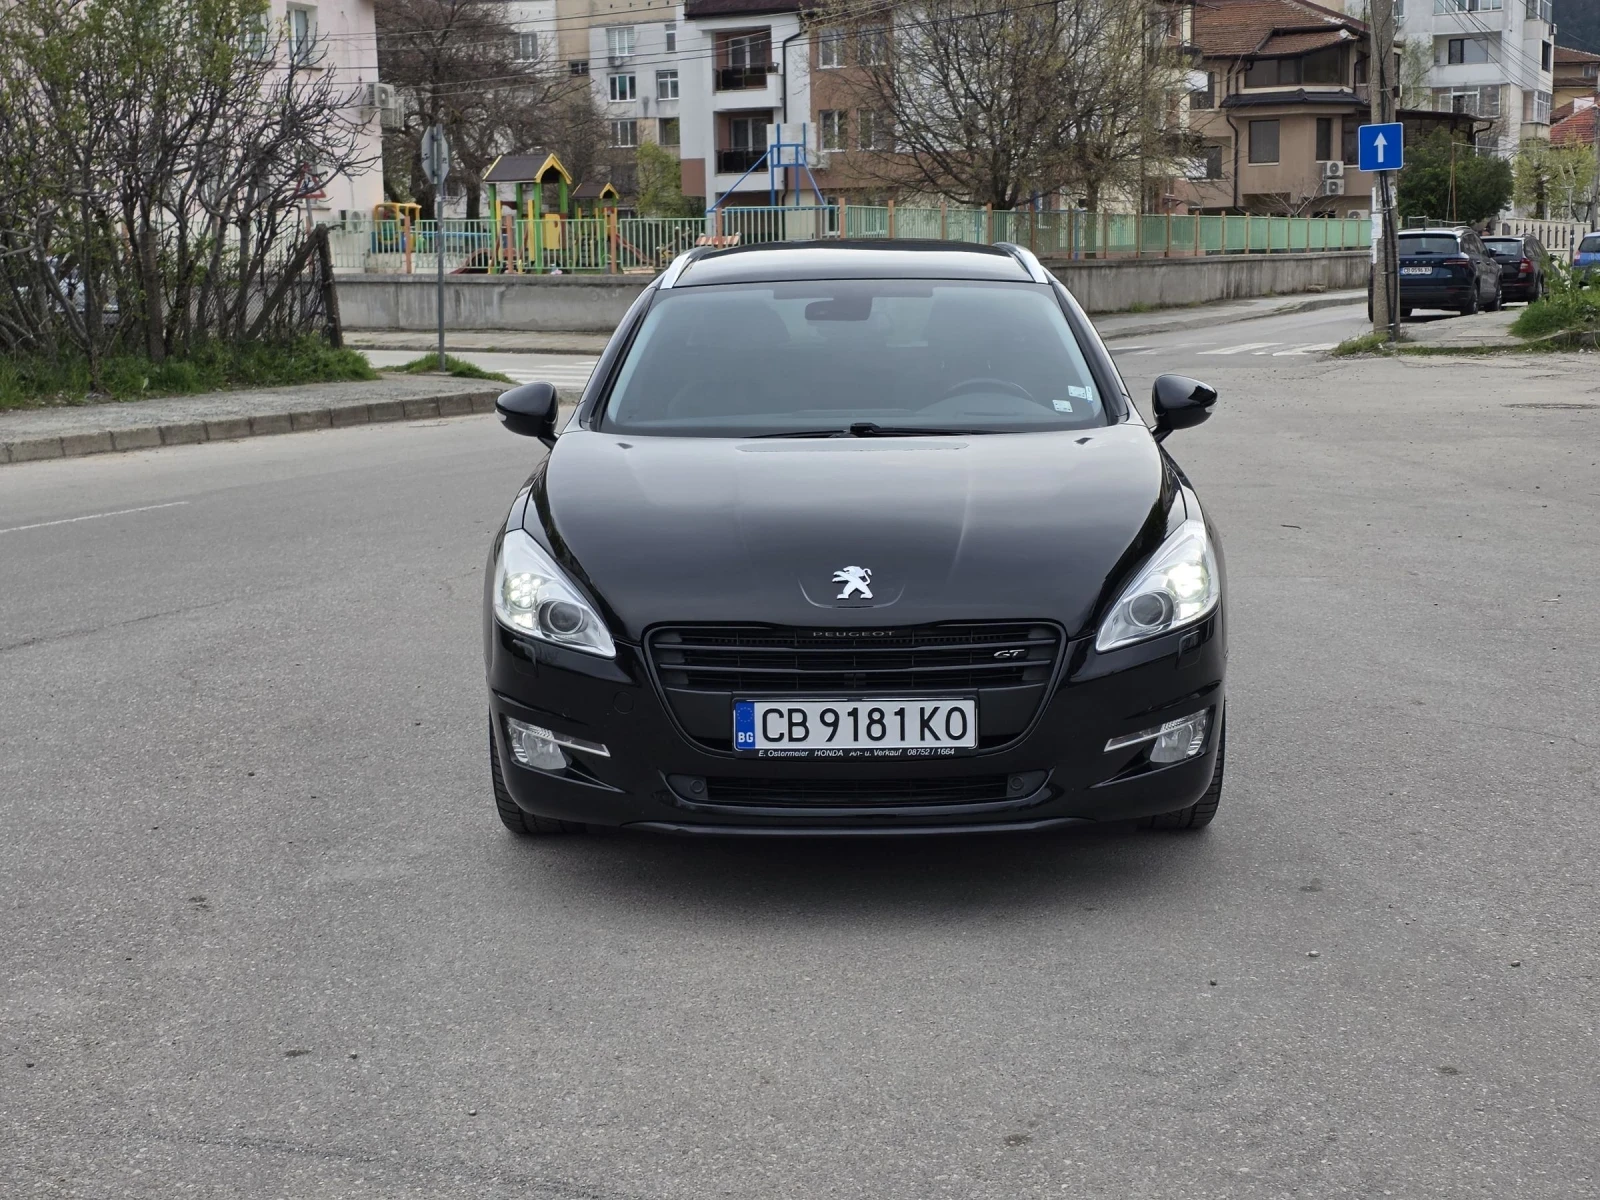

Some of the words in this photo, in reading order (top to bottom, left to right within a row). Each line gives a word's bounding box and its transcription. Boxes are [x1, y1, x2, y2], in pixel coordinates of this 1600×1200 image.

[993, 649, 1025, 659] GT
[761, 707, 810, 743] CB
[819, 706, 906, 743] 9181
[919, 706, 968, 742] KO
[737, 732, 754, 743] BG
[767, 749, 809, 757] Ostermeier
[814, 749, 844, 757] HONDA
[873, 748, 903, 756] Verkauf
[907, 748, 930, 756] 08752
[937, 747, 955, 755] 1664
